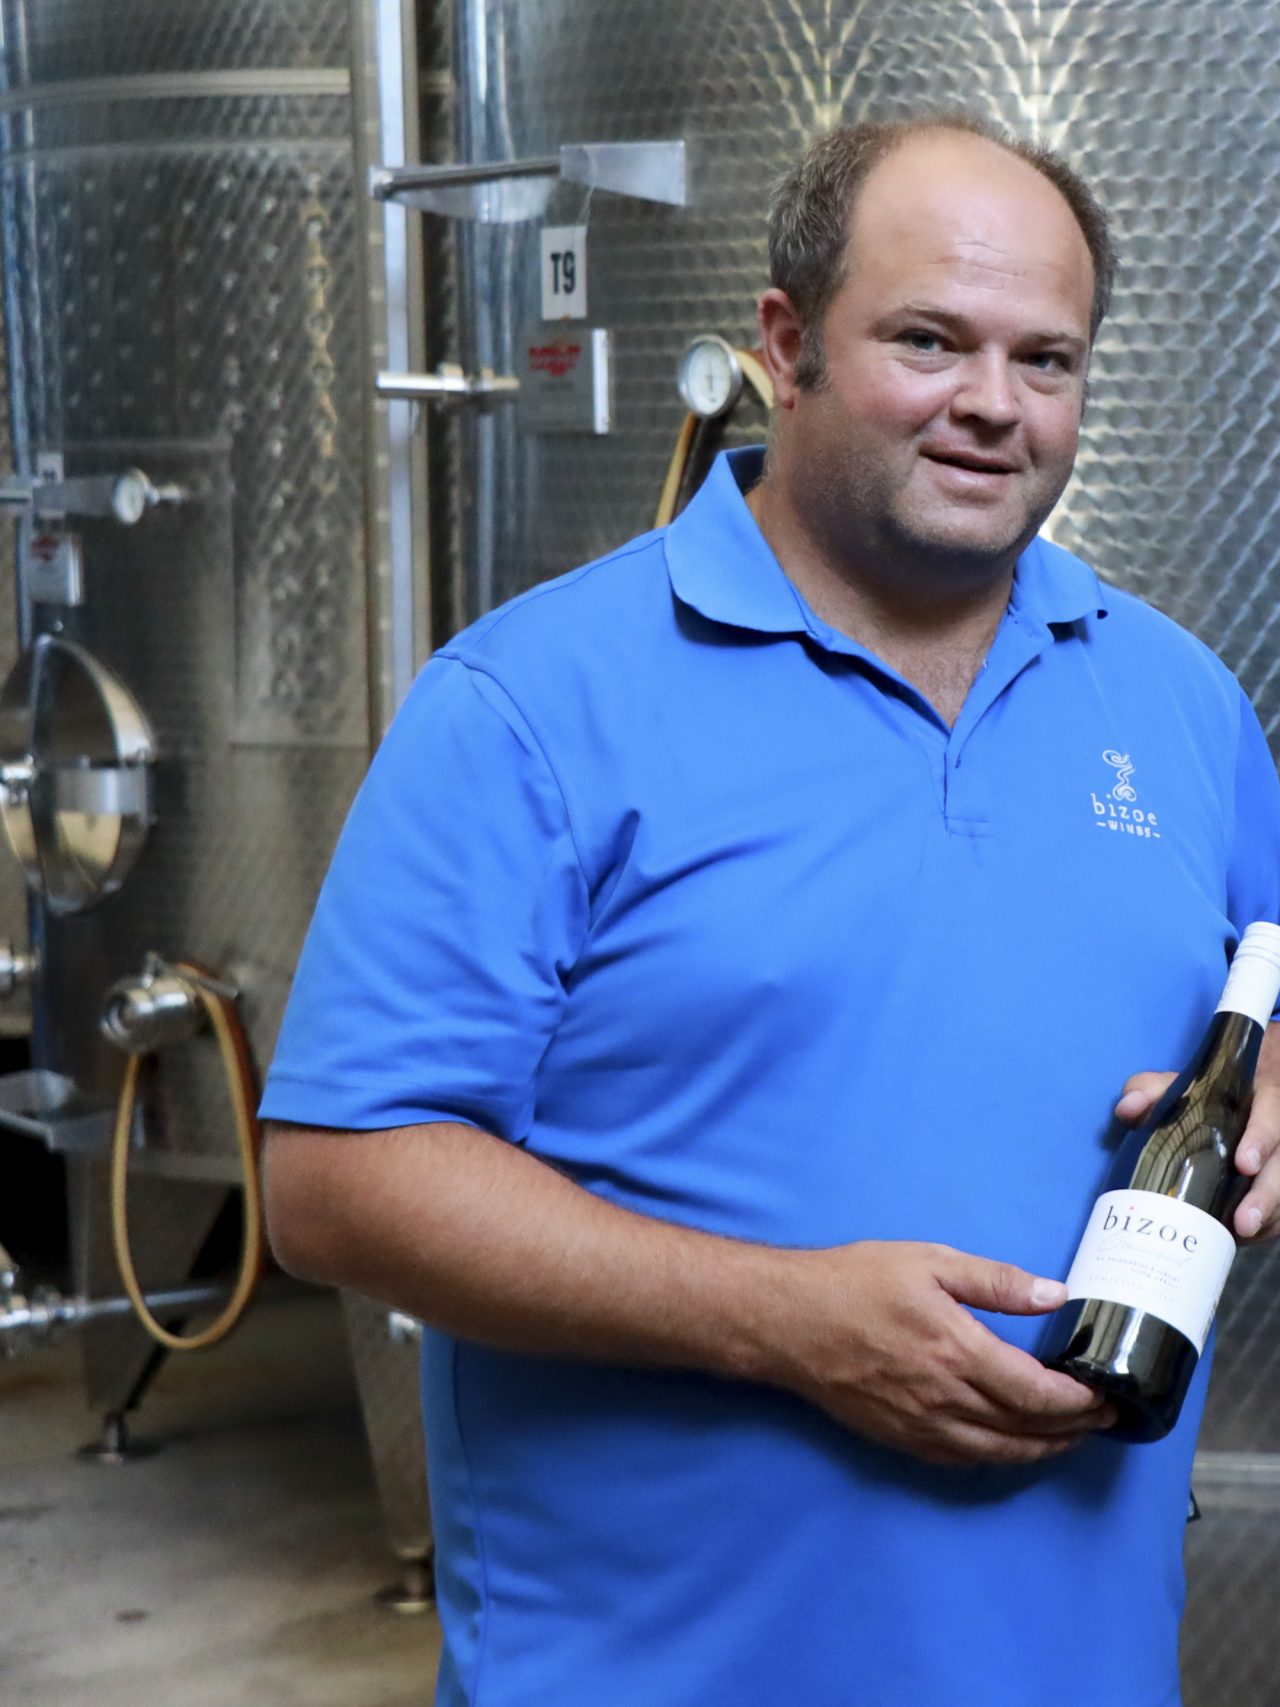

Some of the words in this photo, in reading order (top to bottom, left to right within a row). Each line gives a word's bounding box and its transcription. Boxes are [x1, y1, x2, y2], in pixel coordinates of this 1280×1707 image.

[550, 251, 576, 295] T9
[1090, 792, 1158, 826] bizoe
[1103, 1205, 1198, 1253] bizoe
